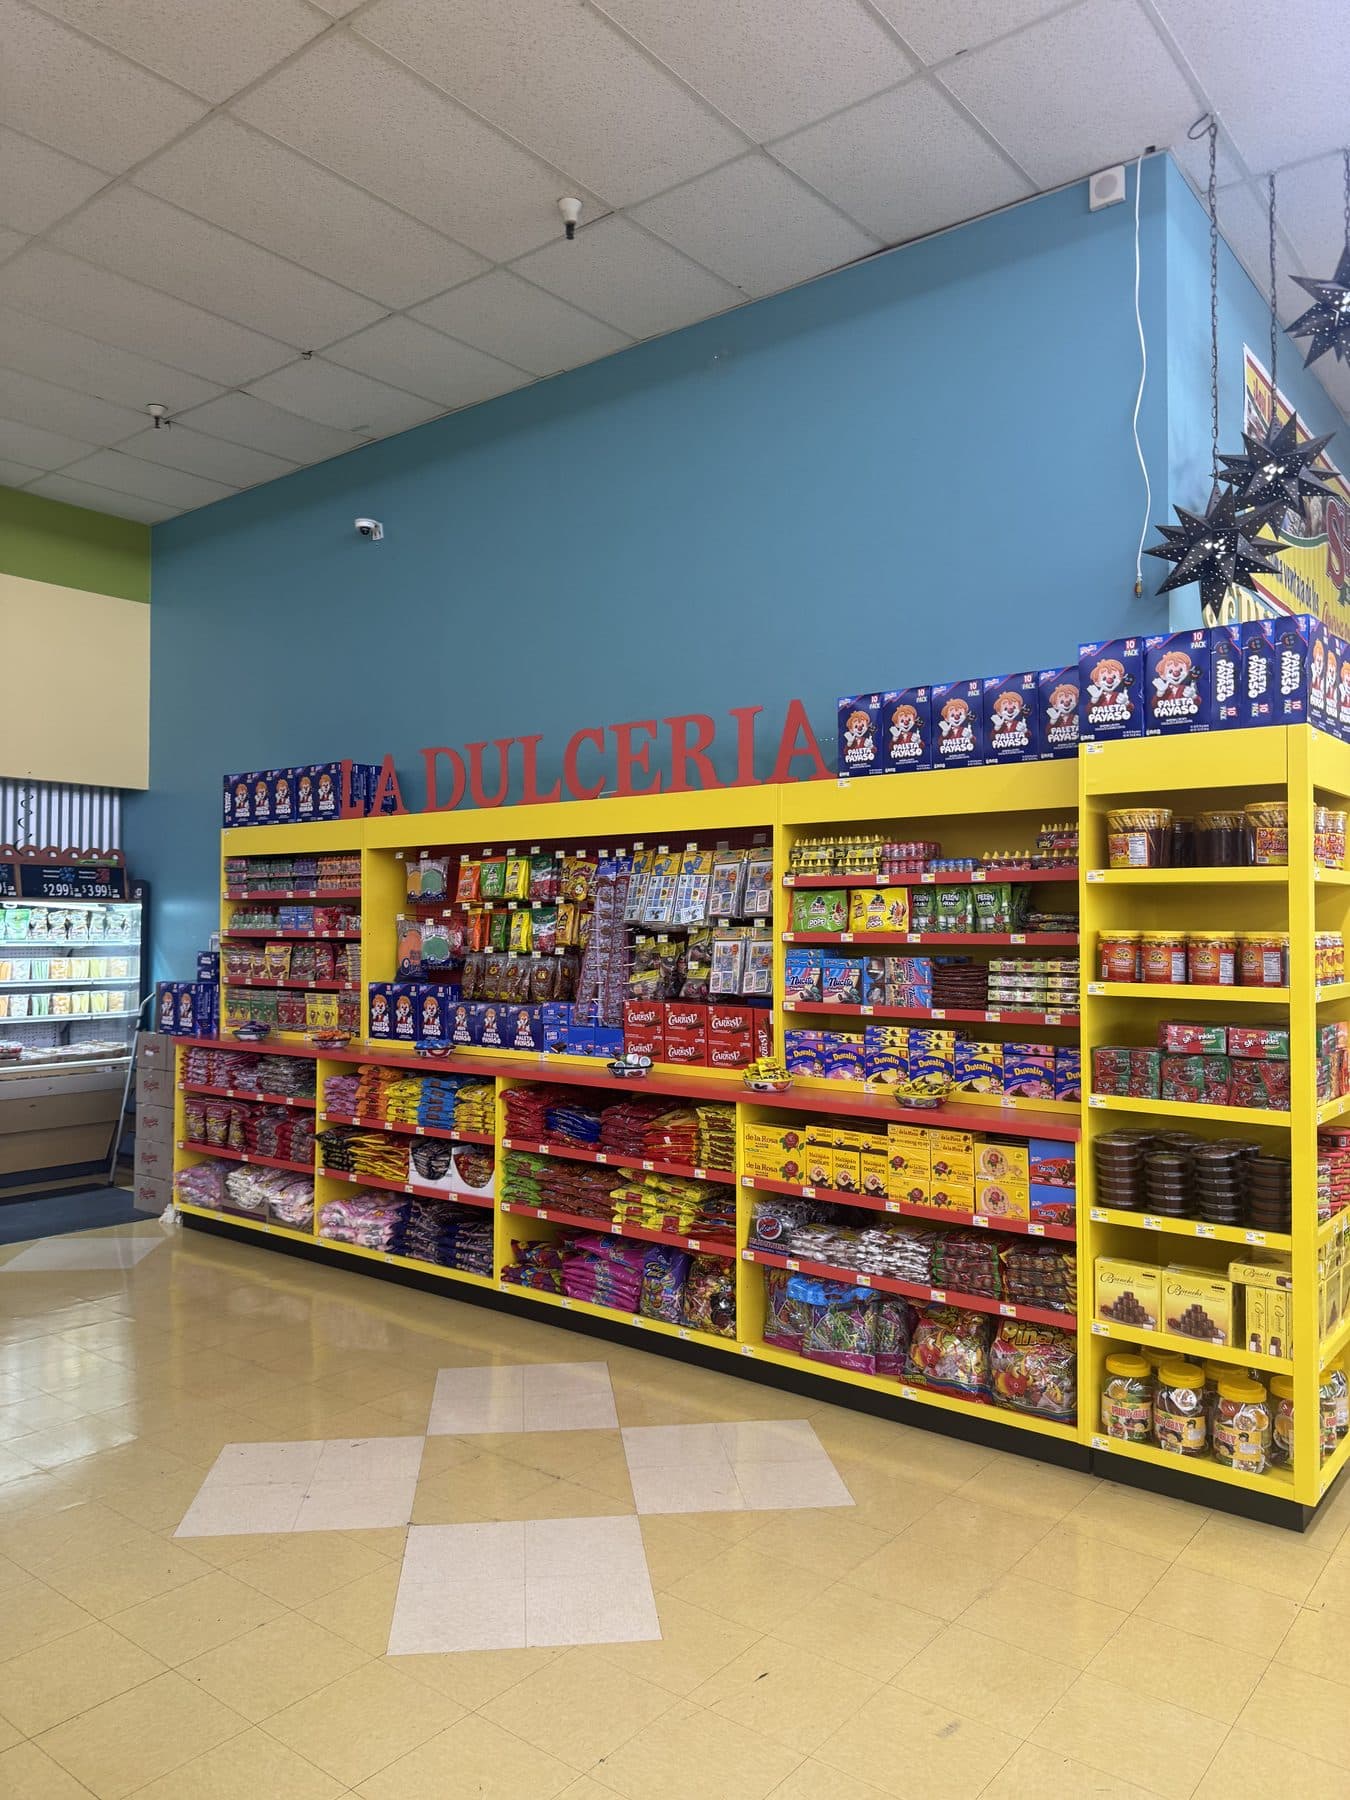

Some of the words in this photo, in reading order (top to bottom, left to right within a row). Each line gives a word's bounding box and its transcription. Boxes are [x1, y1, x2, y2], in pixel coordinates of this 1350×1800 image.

[1193, 632, 1203, 641] 10
[1126, 640, 1135, 649] 10
[1191, 640, 1206, 649] PACK
[1124, 648, 1139, 657] PACK
[1248, 655, 1259, 698] PAYASO
[1258, 657, 1266, 694] PALETA
[1281, 651, 1292, 695] PAYASO
[1291, 654, 1300, 689] PALETA
[1024, 674, 1032, 682] 10
[1216, 659, 1226, 702] PAYASO
[1226, 661, 1234, 697] PALETA
[969, 682, 977, 690] 10
[1022, 681, 1035, 689] PACK
[968, 689, 980, 697] PACK
[1158, 698, 1194, 709] PALETA
[1092, 704, 1126, 715] PALETA
[1154, 705, 1198, 717] PAYASO
[1088, 710, 1131, 723] PAYASO
[994, 732, 1025, 742] PALETA
[1048, 732, 1079, 743] PAYAS
[942, 738, 972, 747] PALETA
[992, 738, 1028, 749] PAYASO
[891, 749, 922, 758] PAYASO
[939, 743, 974, 754] PAYASO
[340, 753, 409, 820] LA
[420, 699, 837, 813] DULCERIA
[845, 753, 875, 762] PAYASO
[762, 1136, 778, 1144] Rosa
[762, 1164, 778, 1172] Rosa
